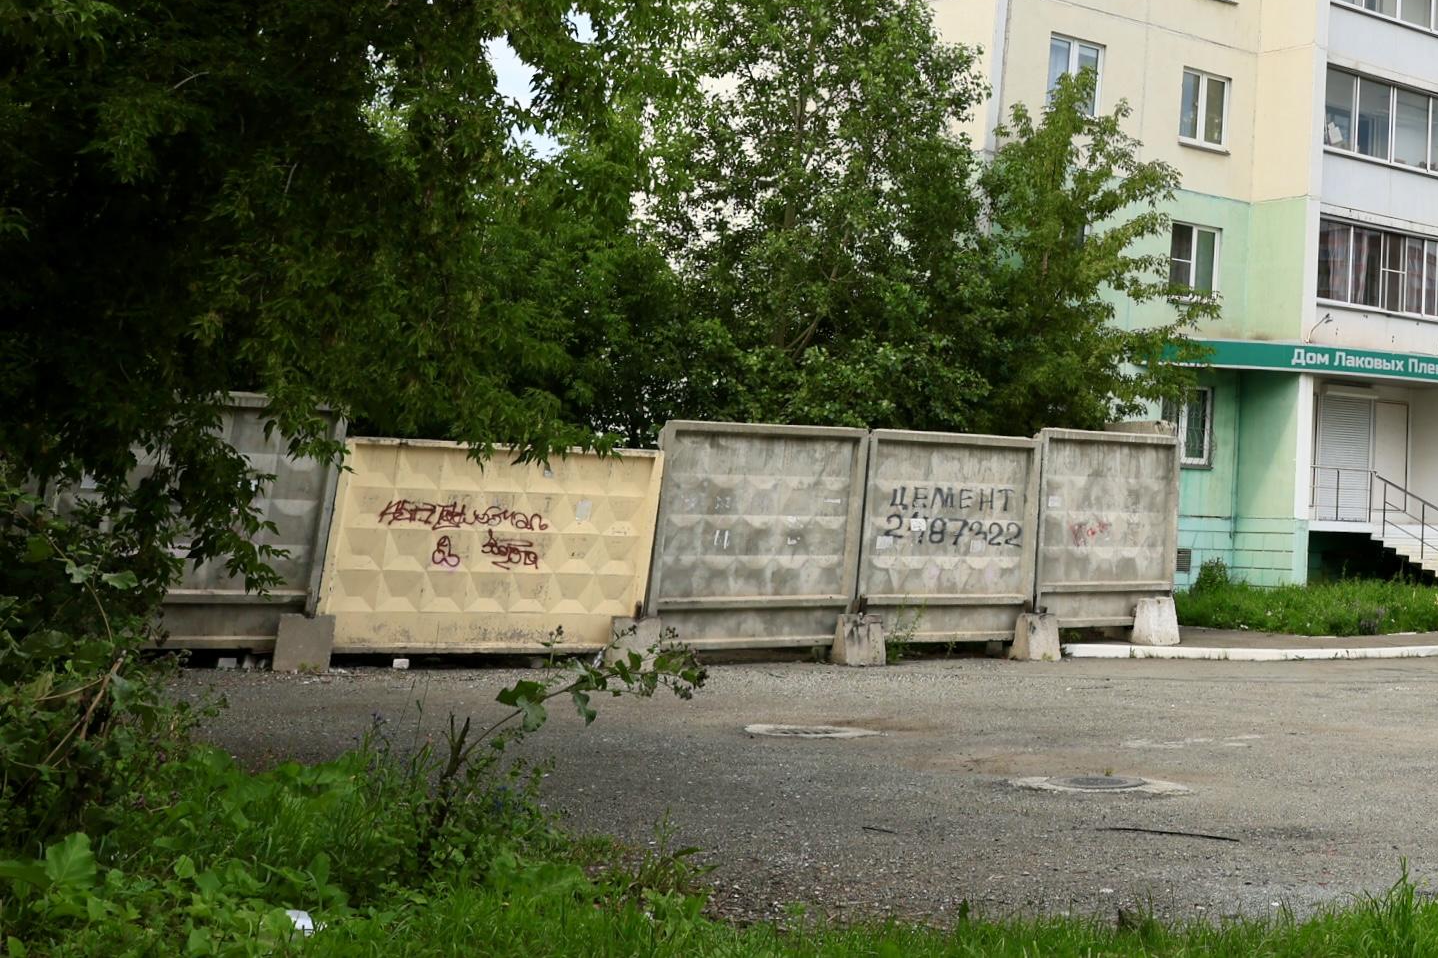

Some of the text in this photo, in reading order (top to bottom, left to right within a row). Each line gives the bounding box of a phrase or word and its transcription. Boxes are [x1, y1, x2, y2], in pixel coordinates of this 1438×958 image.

[1291, 348, 1330, 366] Дом
[1333, 351, 1405, 372] Лаковых
[889, 486, 1015, 511] ЦЕМЕНТ
